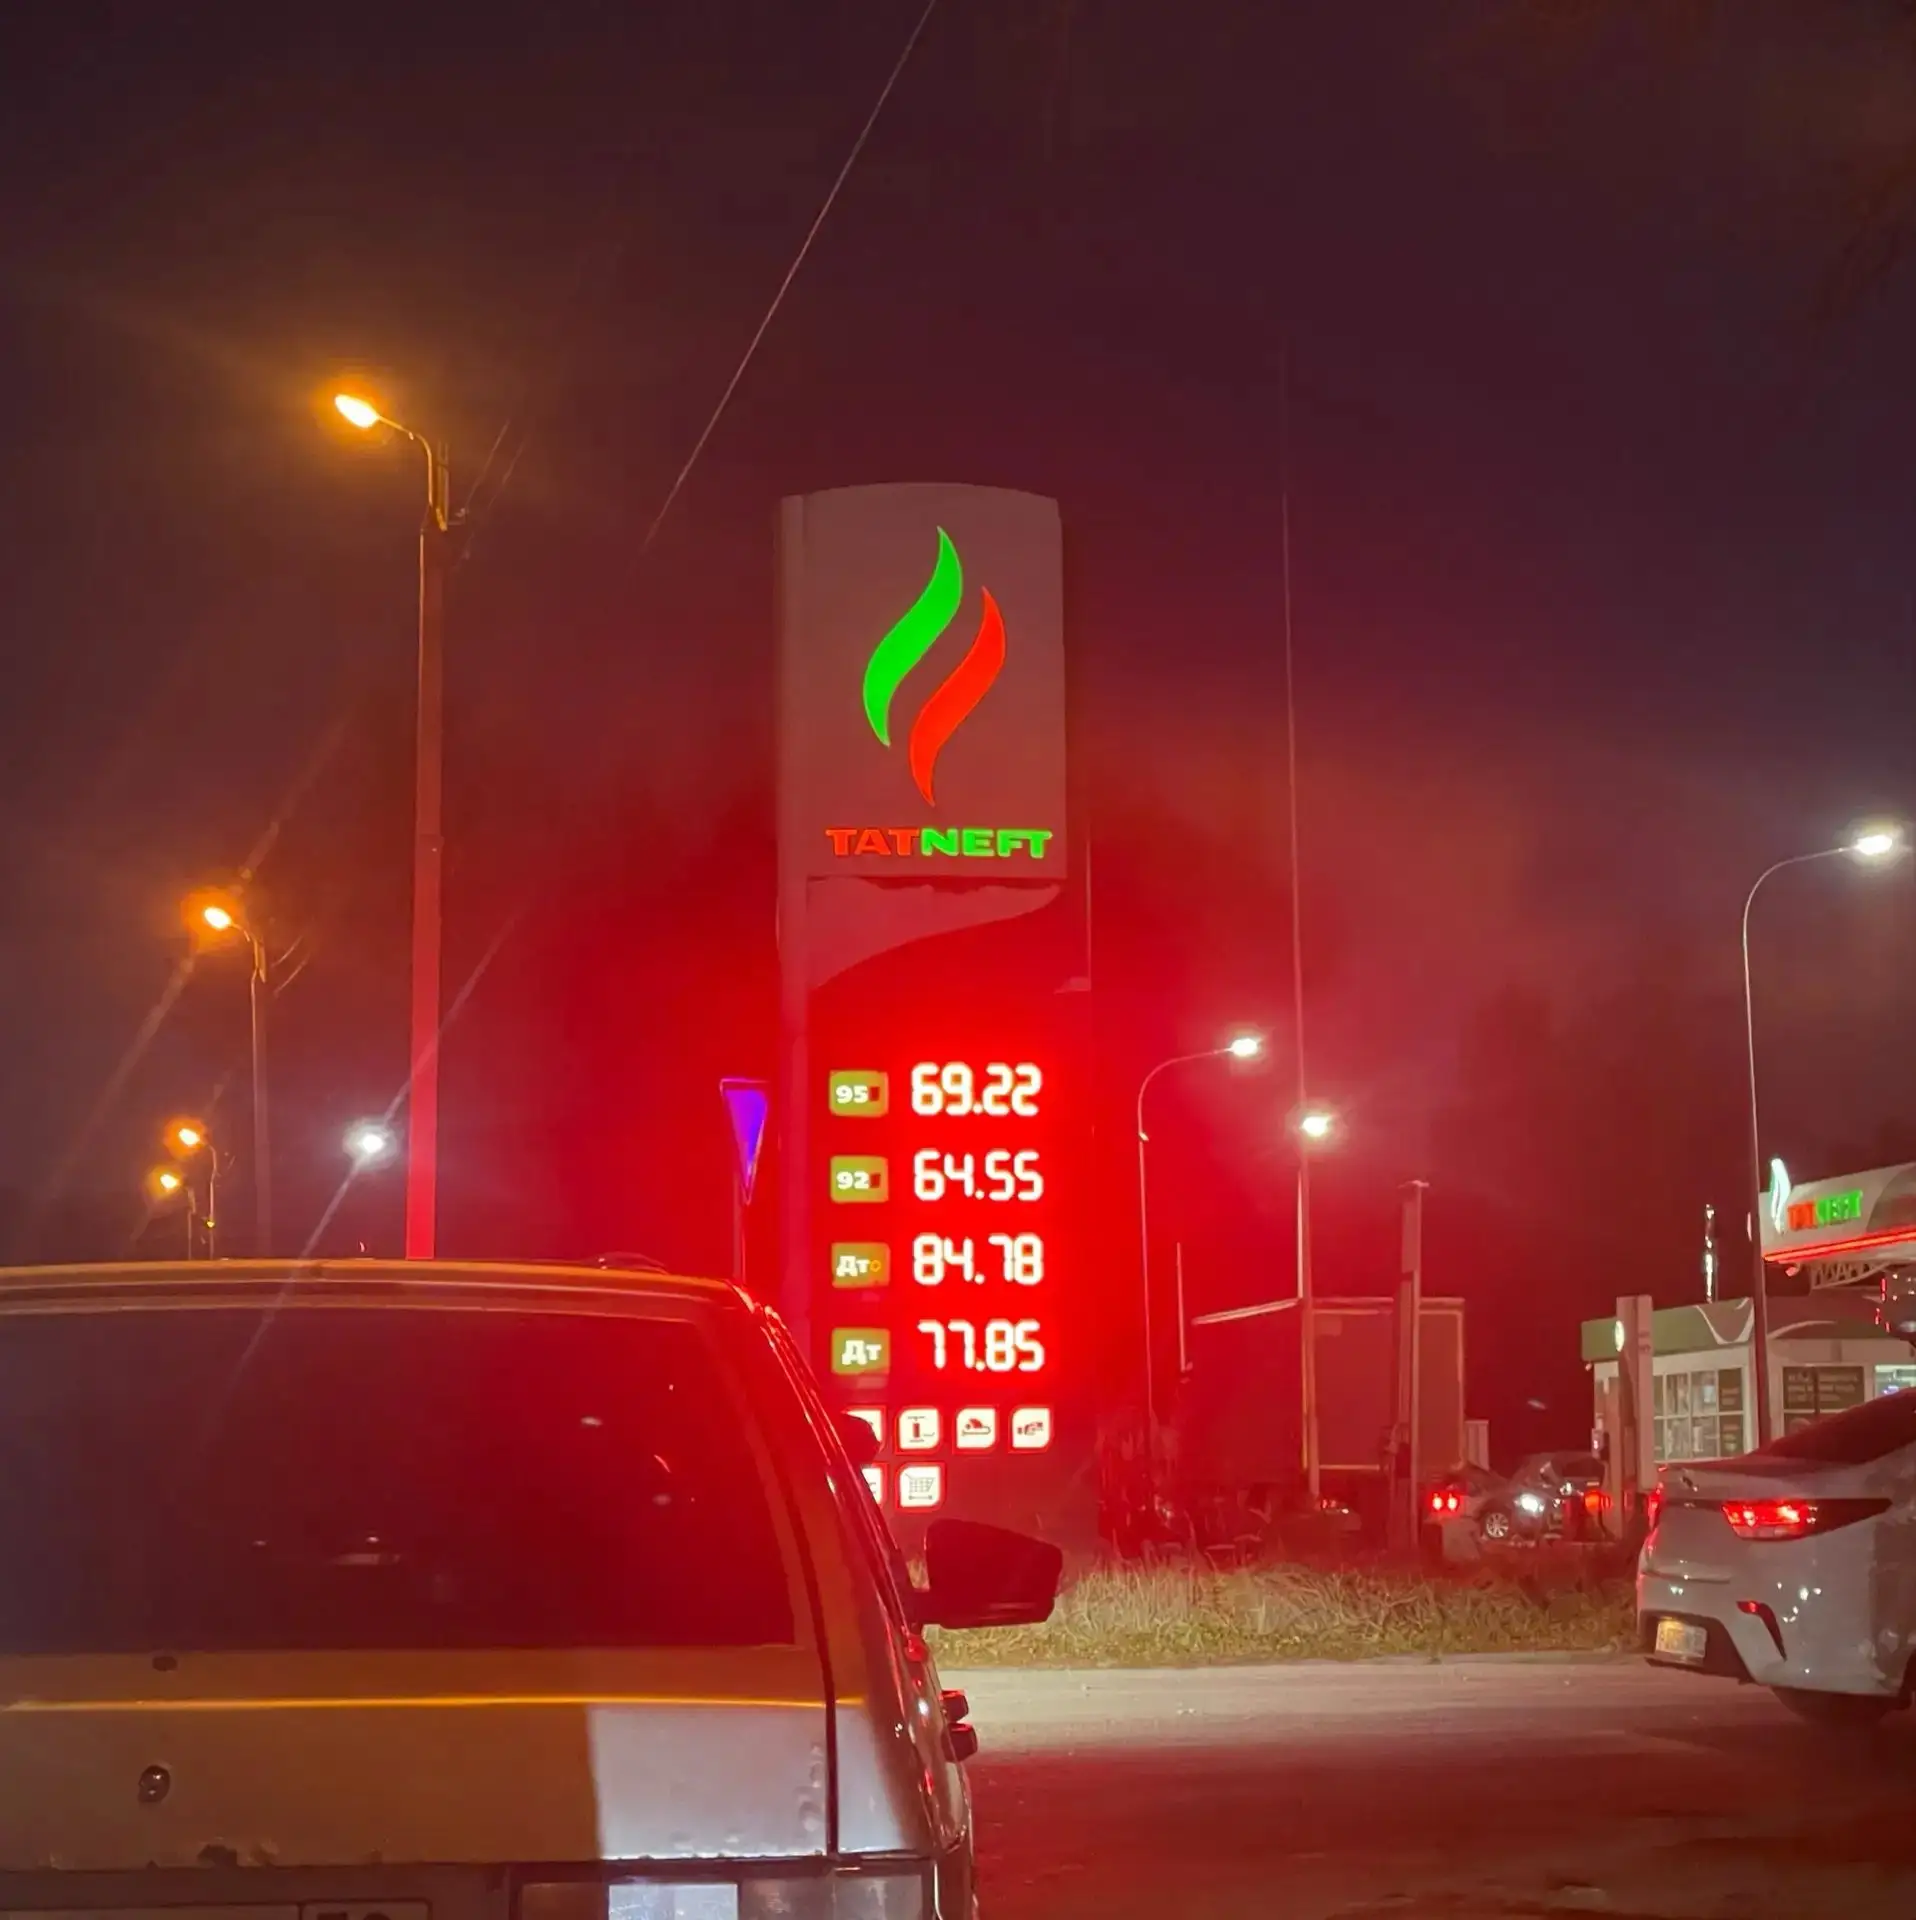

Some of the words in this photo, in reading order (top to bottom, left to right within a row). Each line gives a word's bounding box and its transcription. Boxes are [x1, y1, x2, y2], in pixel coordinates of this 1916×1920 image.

[825, 828, 1053, 859] TATNEFT
[835, 1084, 869, 1104] 95
[911, 1062, 1042, 1116] 69.22
[835, 1171, 870, 1190] 92
[913, 1148, 1043, 1202] 64.55
[913, 1233, 1043, 1285] 84.78
[841, 1340, 882, 1365] Дт
[917, 1319, 1044, 1372] 77.85
